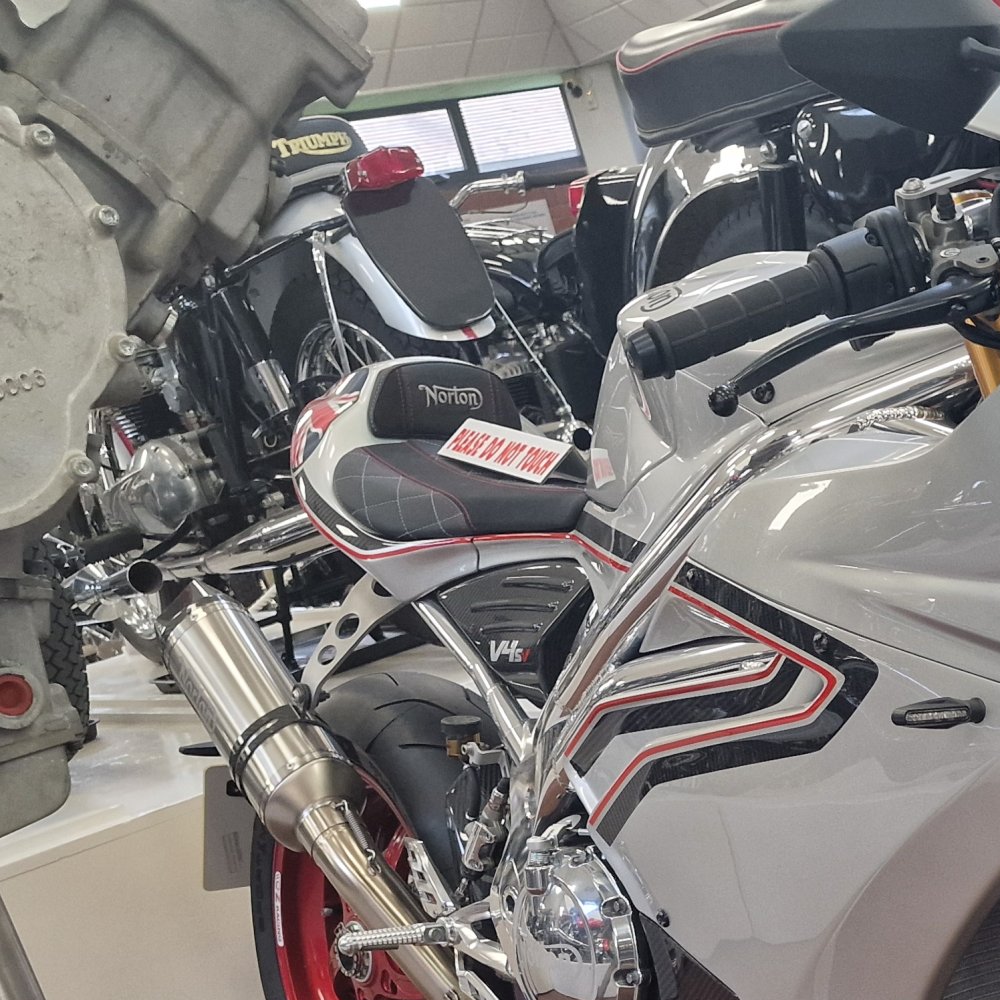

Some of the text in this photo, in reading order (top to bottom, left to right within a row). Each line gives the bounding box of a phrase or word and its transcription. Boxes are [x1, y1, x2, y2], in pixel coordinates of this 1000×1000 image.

[272, 132, 350, 158] TRIUMPH
[418, 385, 483, 410] Norton
[446, 428, 491, 456] PLEASE
[479, 437, 506, 461] DO
[494, 441, 528, 467] NOT
[516, 446, 560, 475] TOUCH
